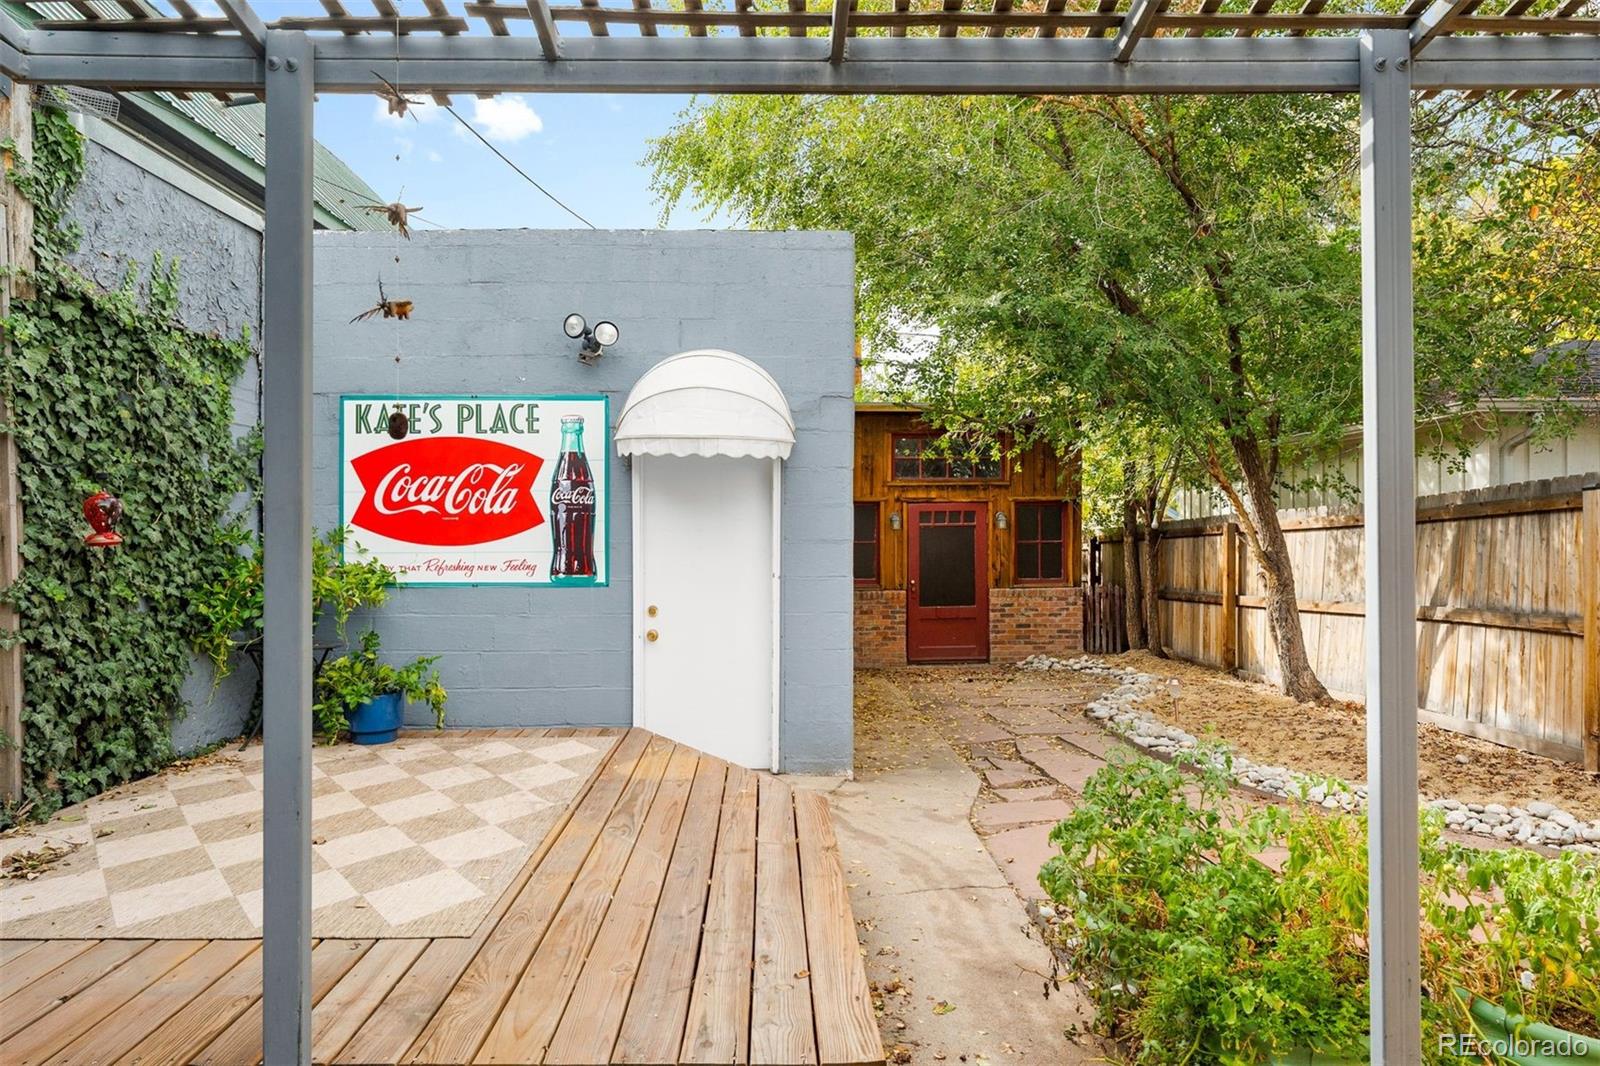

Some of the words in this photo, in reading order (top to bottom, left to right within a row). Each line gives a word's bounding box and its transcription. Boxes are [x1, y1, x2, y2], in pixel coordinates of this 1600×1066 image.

[457, 403, 539, 434] PLACE
[373, 463, 525, 515] Coca-Cola
[422, 558, 475, 578] Refreshing
[500, 558, 537, 578] Feeling
